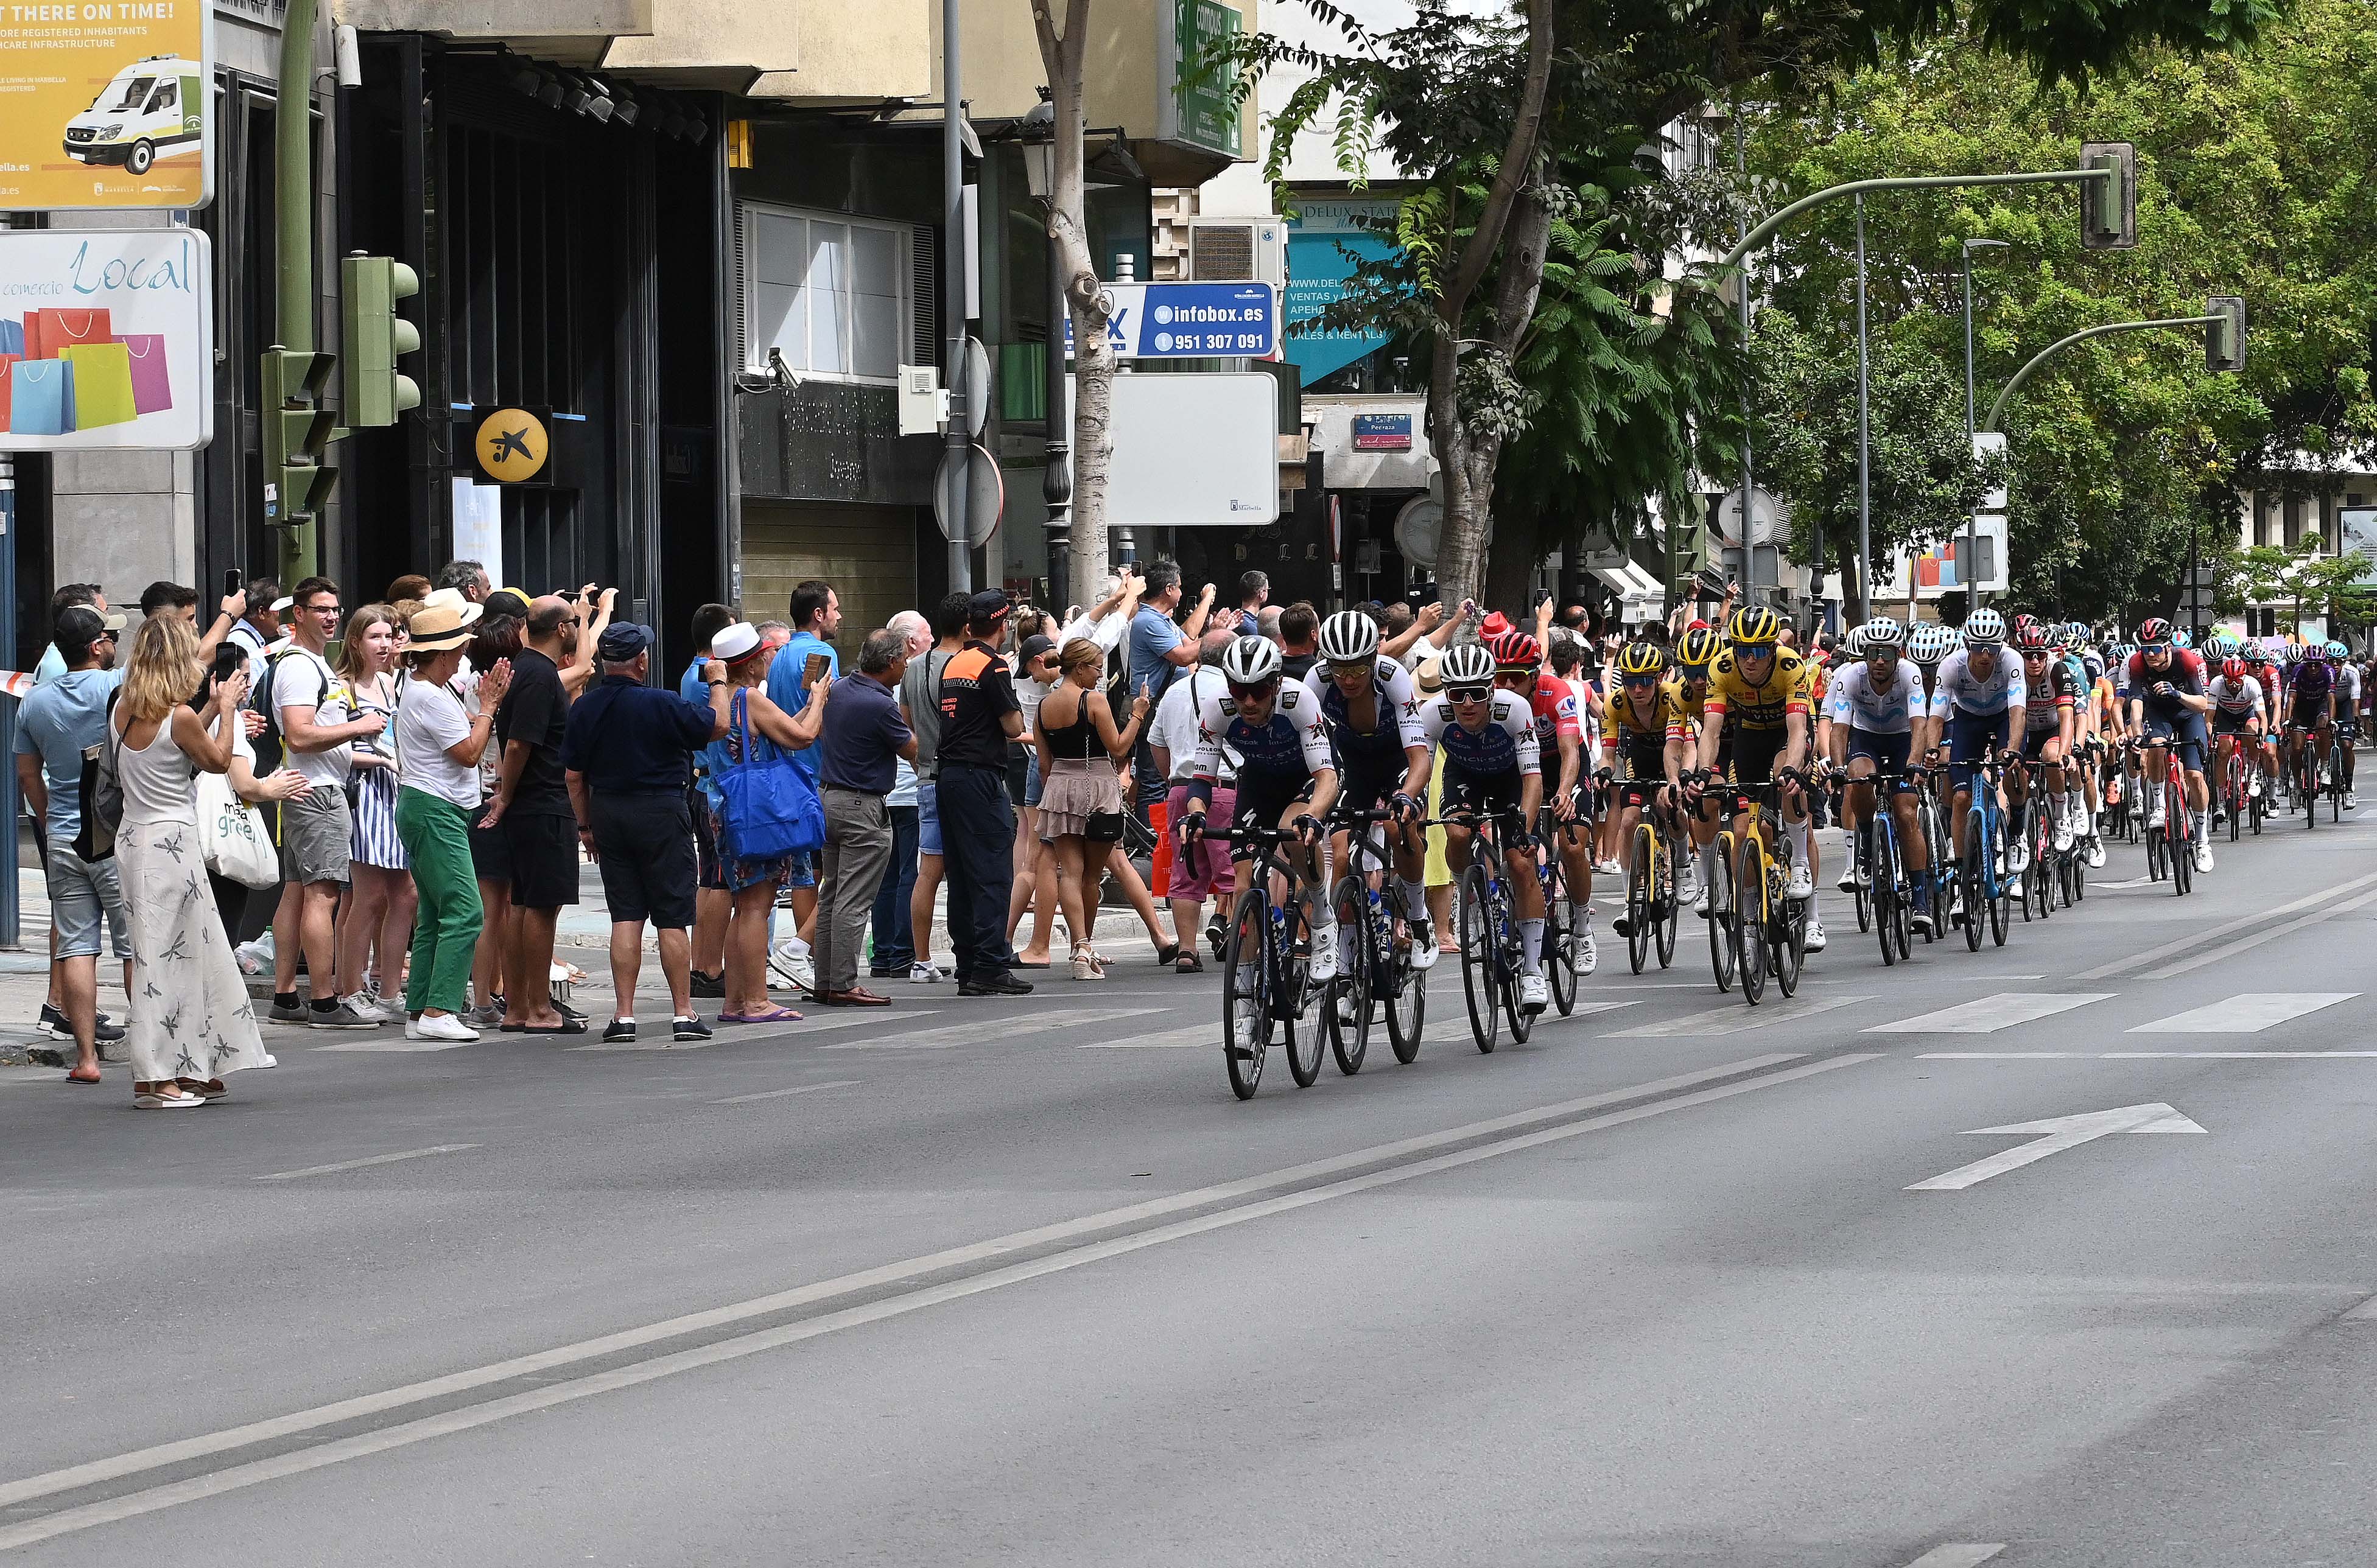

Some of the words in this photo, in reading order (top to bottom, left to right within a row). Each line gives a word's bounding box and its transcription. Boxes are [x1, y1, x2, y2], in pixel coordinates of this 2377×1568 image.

[12, 5, 75, 21] THERE
[83, 4, 111, 20] ON
[118, 2, 174, 19] TIME!
[23, 27, 81, 37] REGISTERED
[84, 27, 147, 36] INHABITANTS
[30, 39, 115, 49] INFRASTRUCTURE
[69, 238, 191, 294] Local
[3, 281, 63, 295] comercio
[1290, 292, 1330, 301] VENTAS
[1174, 306, 1264, 323] infobox.es
[1175, 334, 1201, 349] 951
[1206, 334, 1232, 349] 307
[1238, 334, 1263, 349] 091
[1327, 331, 1334, 340] &
[218, 815, 259, 845] gree
